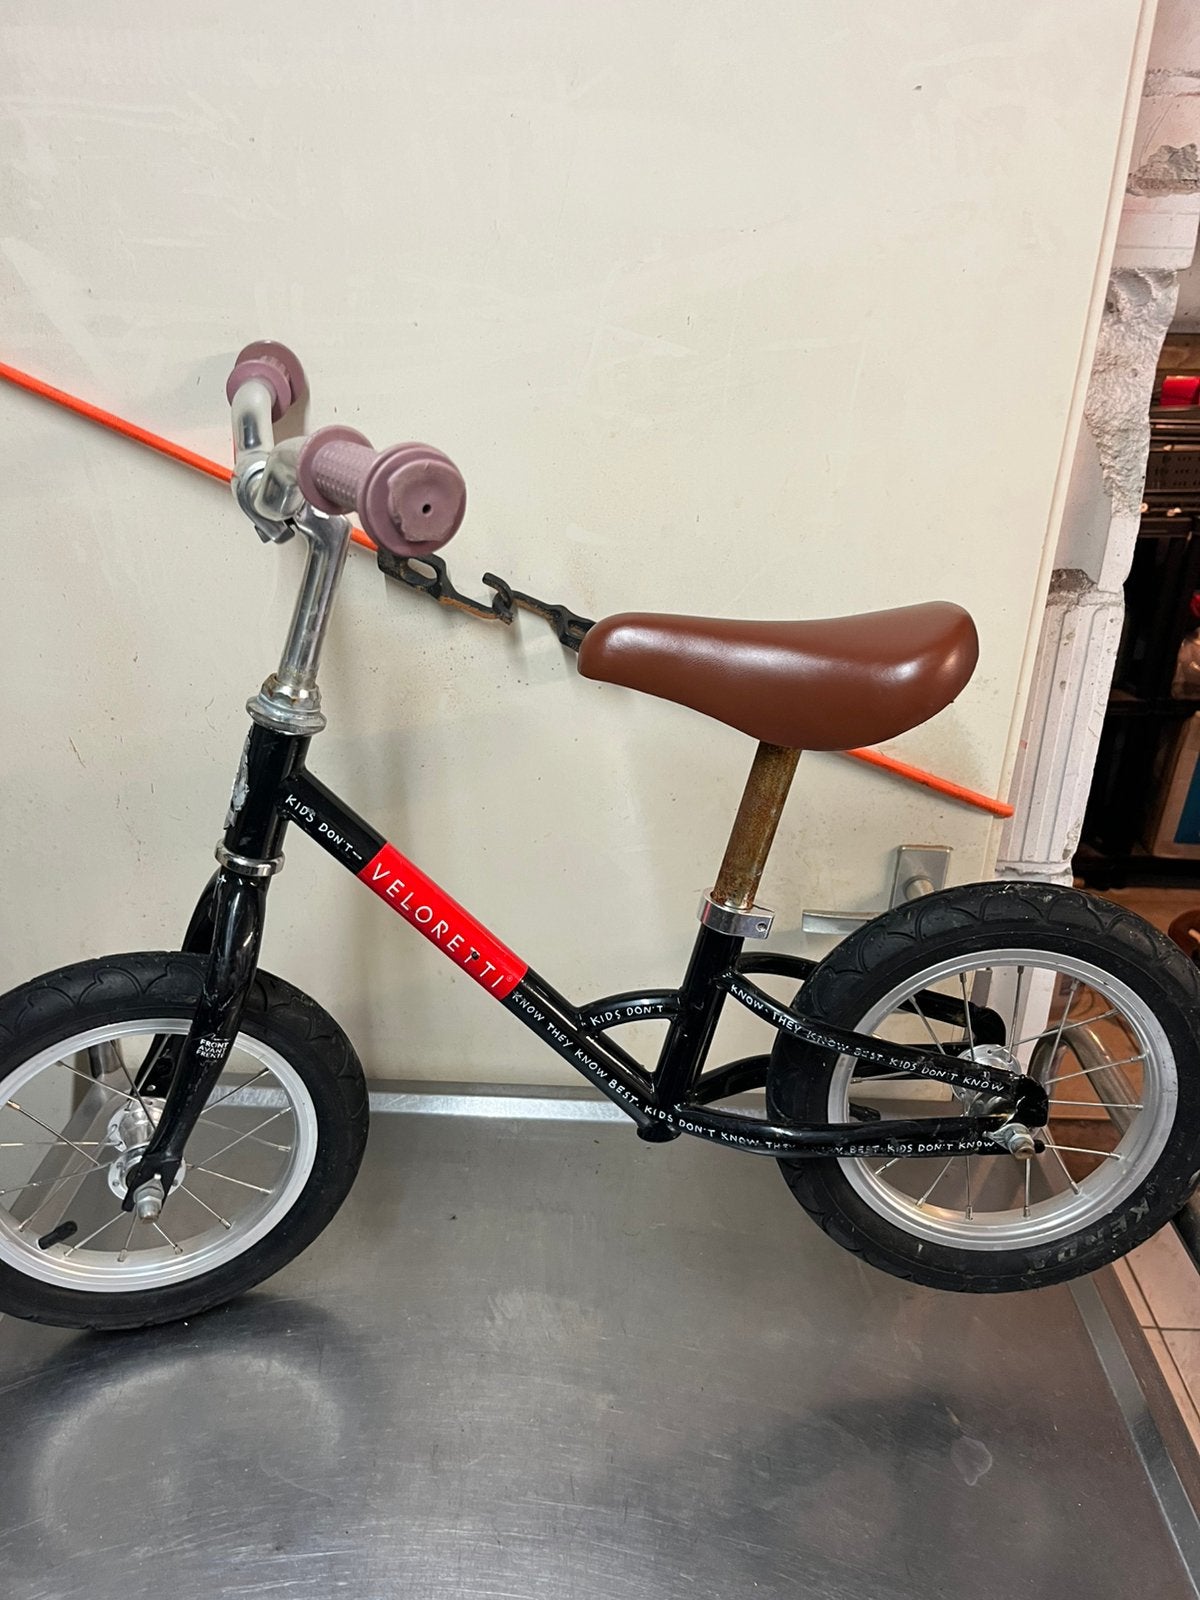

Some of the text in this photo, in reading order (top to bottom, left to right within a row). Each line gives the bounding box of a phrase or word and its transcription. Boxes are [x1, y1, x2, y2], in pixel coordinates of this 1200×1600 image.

[285, 794, 316, 823] KIDS
[371, 862, 505, 988] VELORETTI
[511, 991, 544, 1022] KNOW
[547, 1022, 574, 1048] THEY
[575, 1049, 608, 1078] KNOW
[589, 1005, 664, 1027] KIDS DON'T
[200, 1039, 229, 1048] FRONT
[771, 1011, 802, 1035] THEY
[806, 1030, 850, 1051] KNOW
[889, 1057, 917, 1071] KIDS
[921, 1066, 958, 1081] DON'T
[962, 1076, 1005, 1093] KNOW
[644, 1105, 674, 1123] KIDS
[678, 1119, 716, 1138] DON'T
[720, 1131, 760, 1146] KNOW
[887, 1143, 913, 1154] KIDS
[917, 1143, 954, 1153] DON'T
[958, 1140, 995, 1150] KNOW
